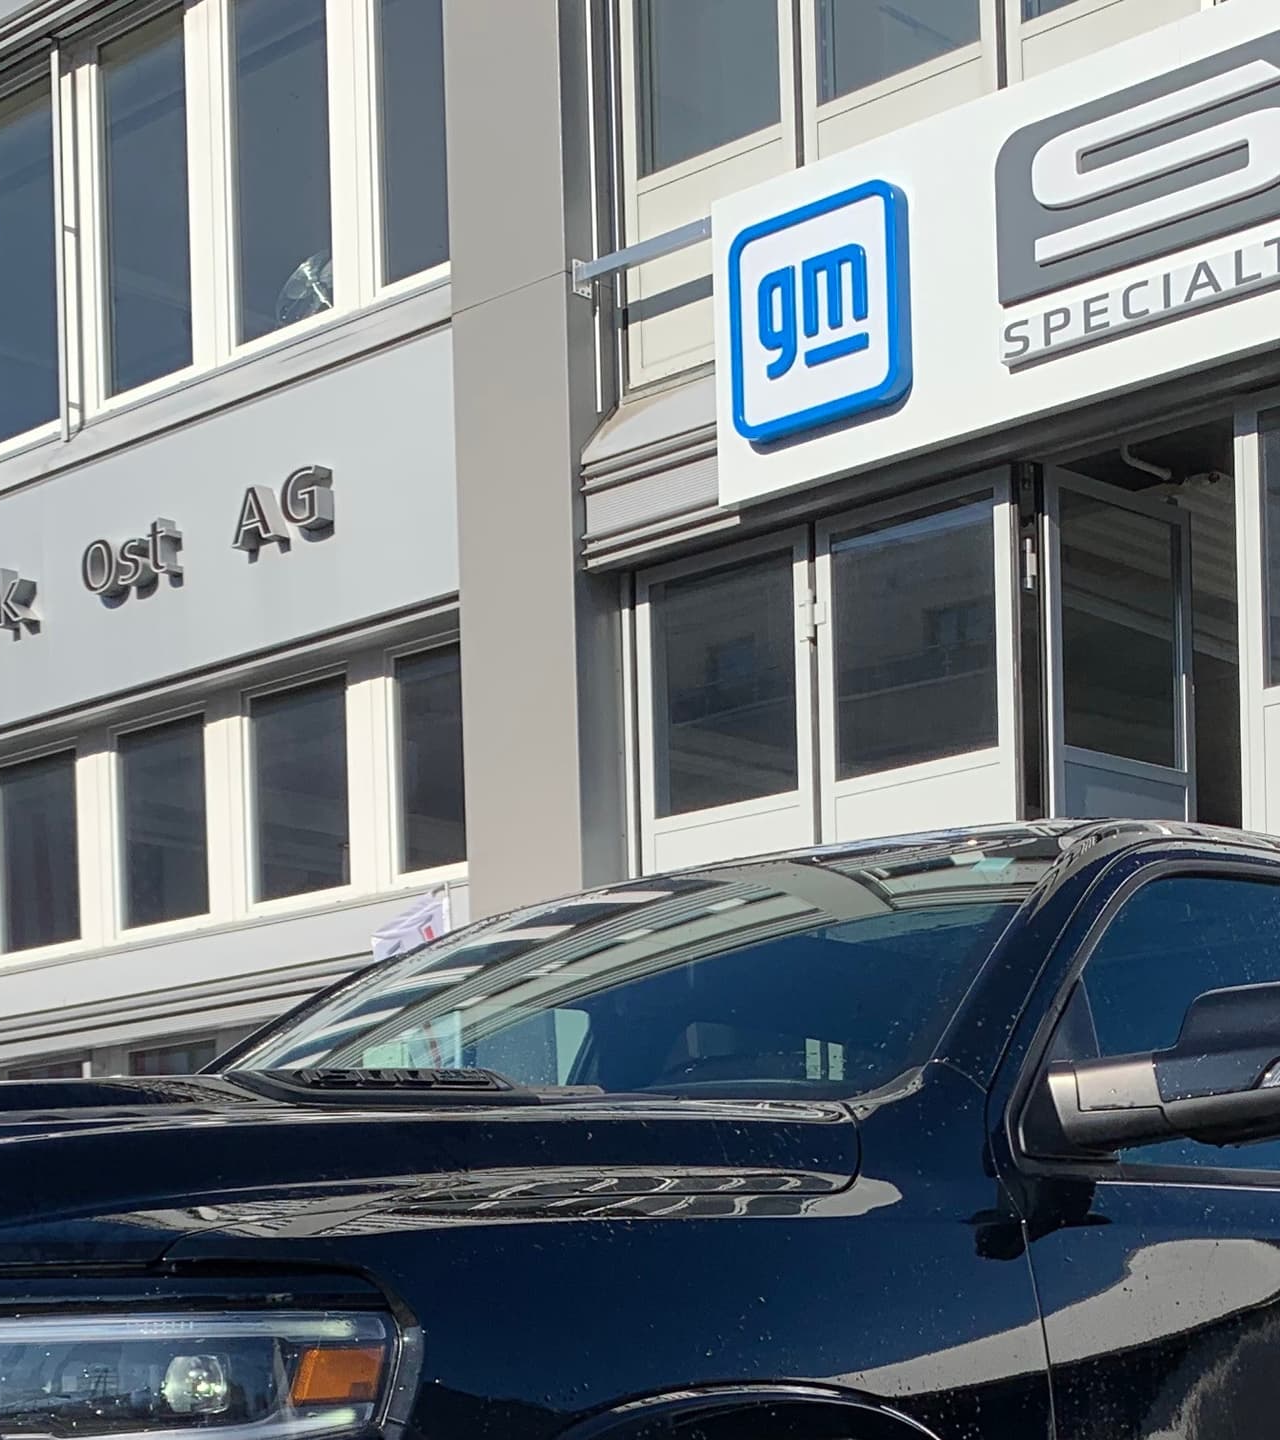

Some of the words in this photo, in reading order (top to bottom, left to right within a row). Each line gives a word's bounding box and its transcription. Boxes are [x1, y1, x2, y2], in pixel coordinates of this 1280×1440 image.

[757, 242, 870, 381] gm
[82, 518, 181, 598] Ost
[232, 465, 335, 552] AG
